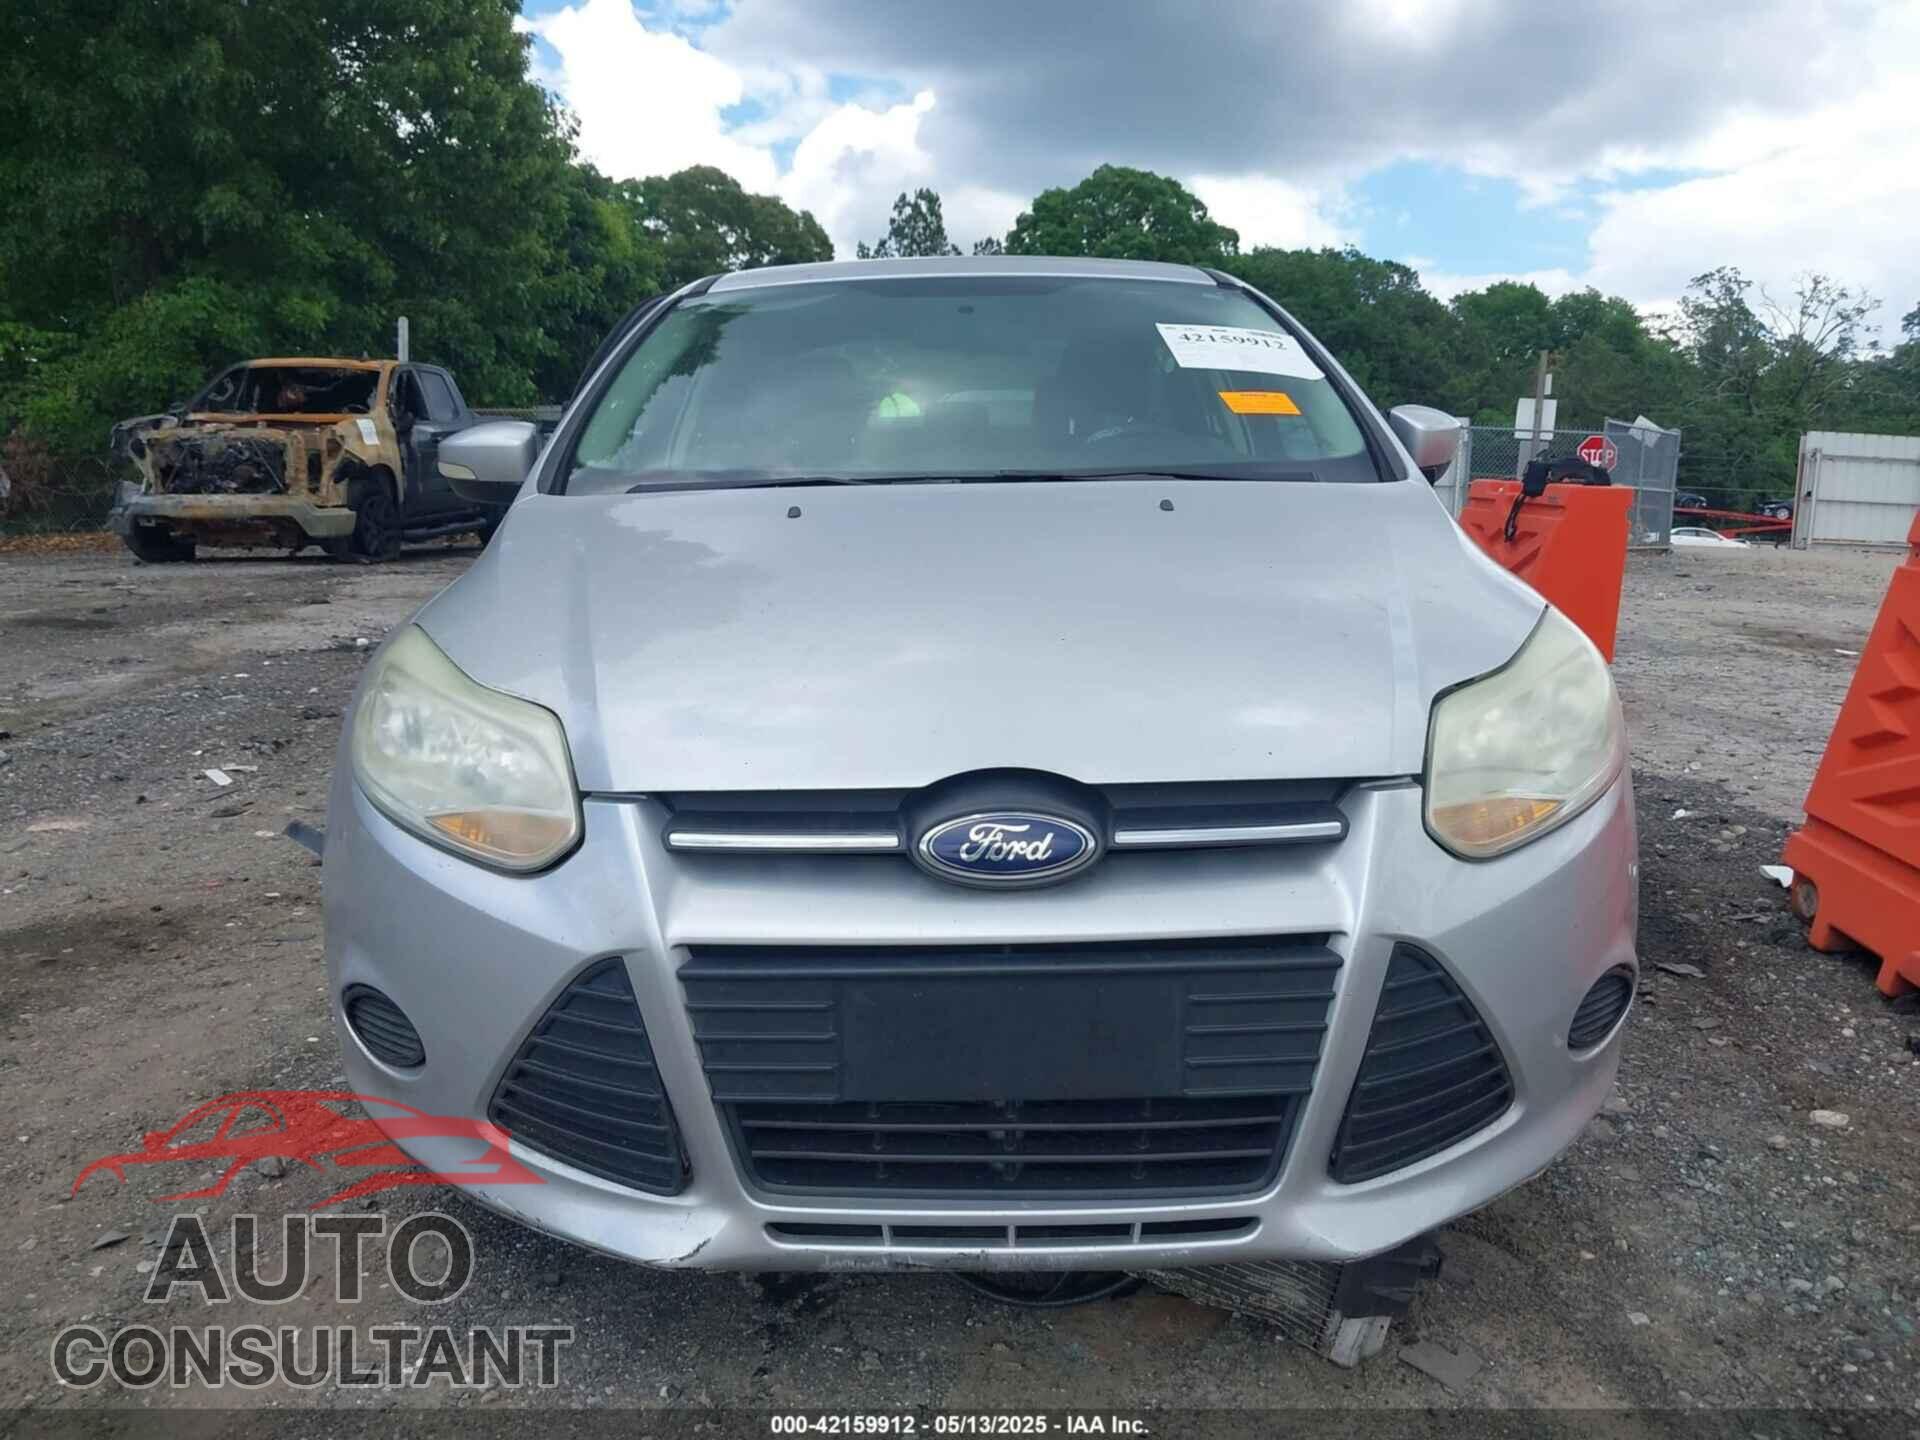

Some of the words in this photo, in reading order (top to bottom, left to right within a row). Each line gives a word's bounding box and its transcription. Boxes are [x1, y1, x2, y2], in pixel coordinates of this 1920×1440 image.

[1179, 333, 1287, 351] 42159912
[1581, 449, 1614, 465] STOP
[959, 823, 1054, 862] Ford
